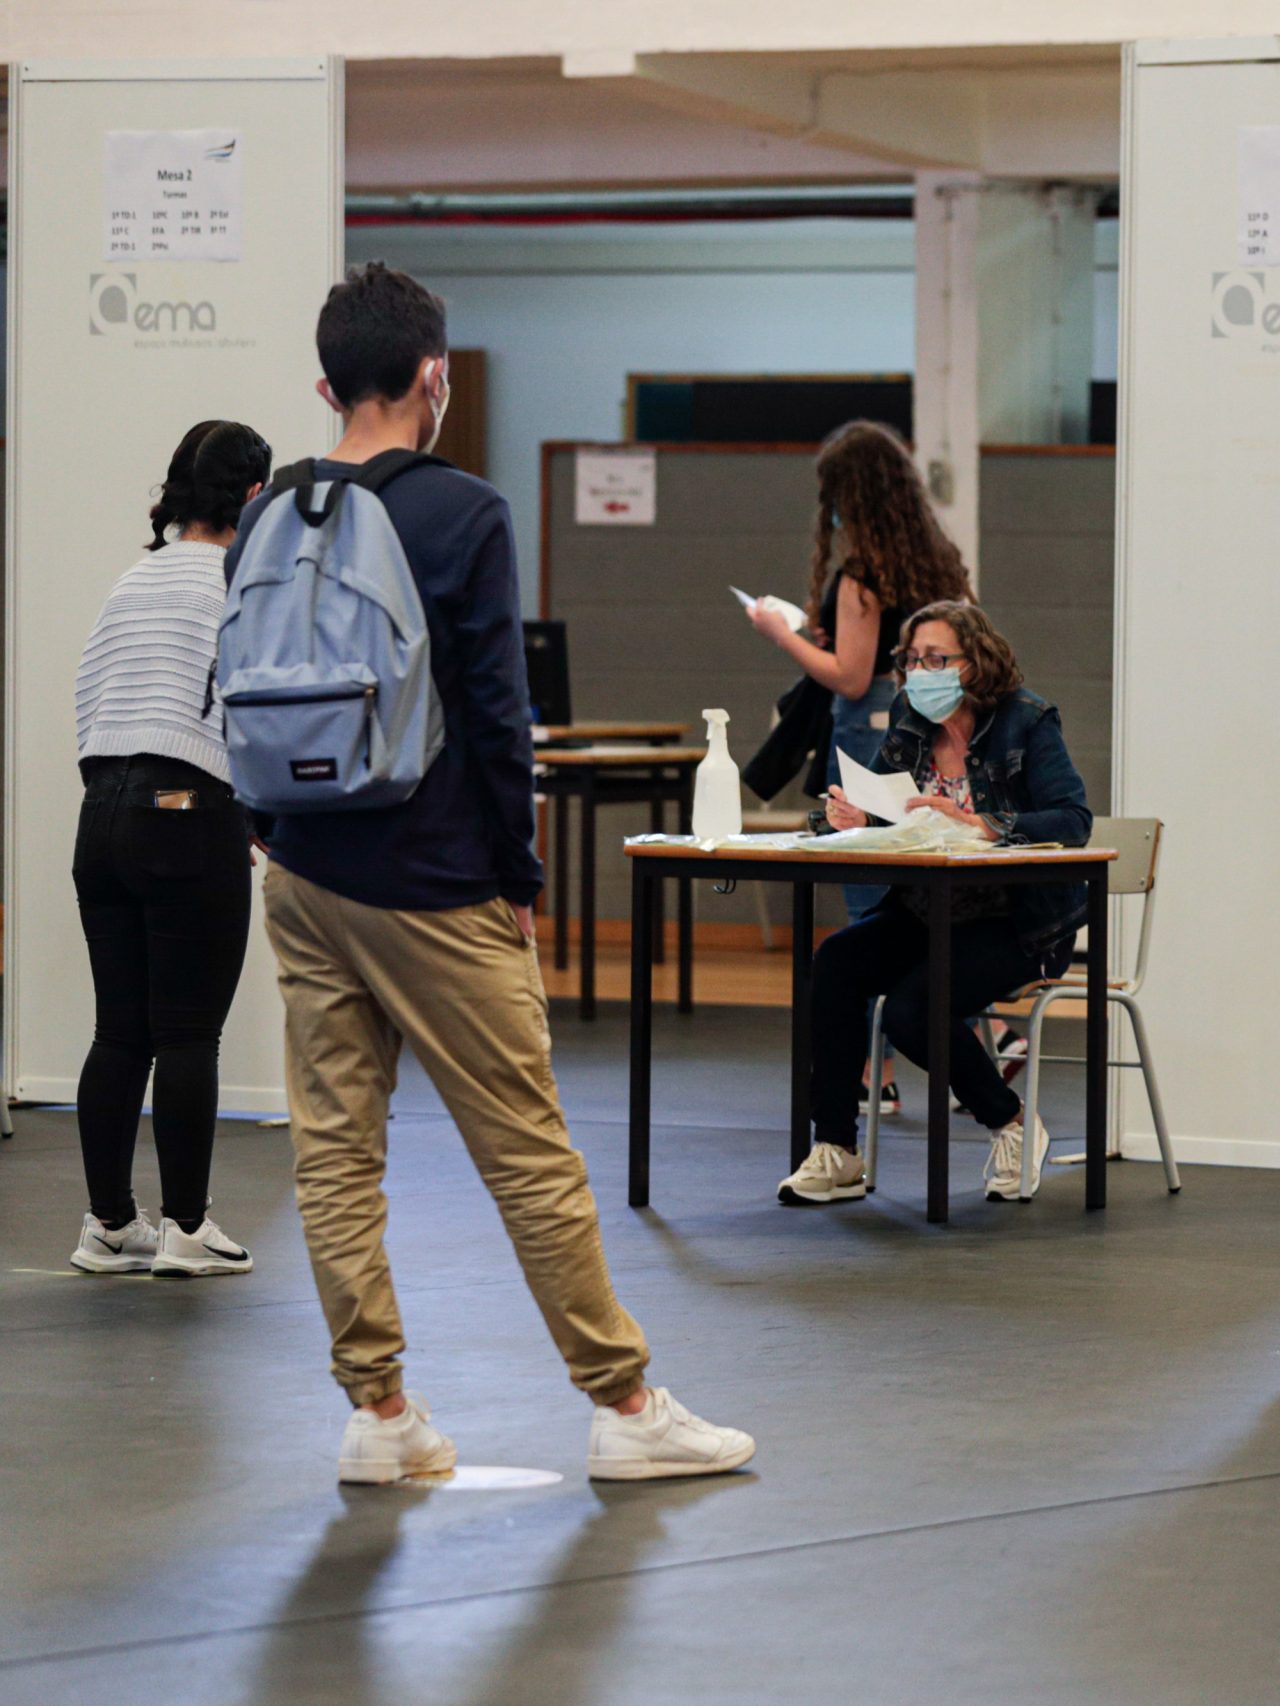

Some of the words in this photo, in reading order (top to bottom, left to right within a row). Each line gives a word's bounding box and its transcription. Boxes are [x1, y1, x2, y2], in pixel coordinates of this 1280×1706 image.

[157, 169, 184, 181] Mesa
[187, 168, 193, 181] 2
[134, 301, 217, 332] ema
